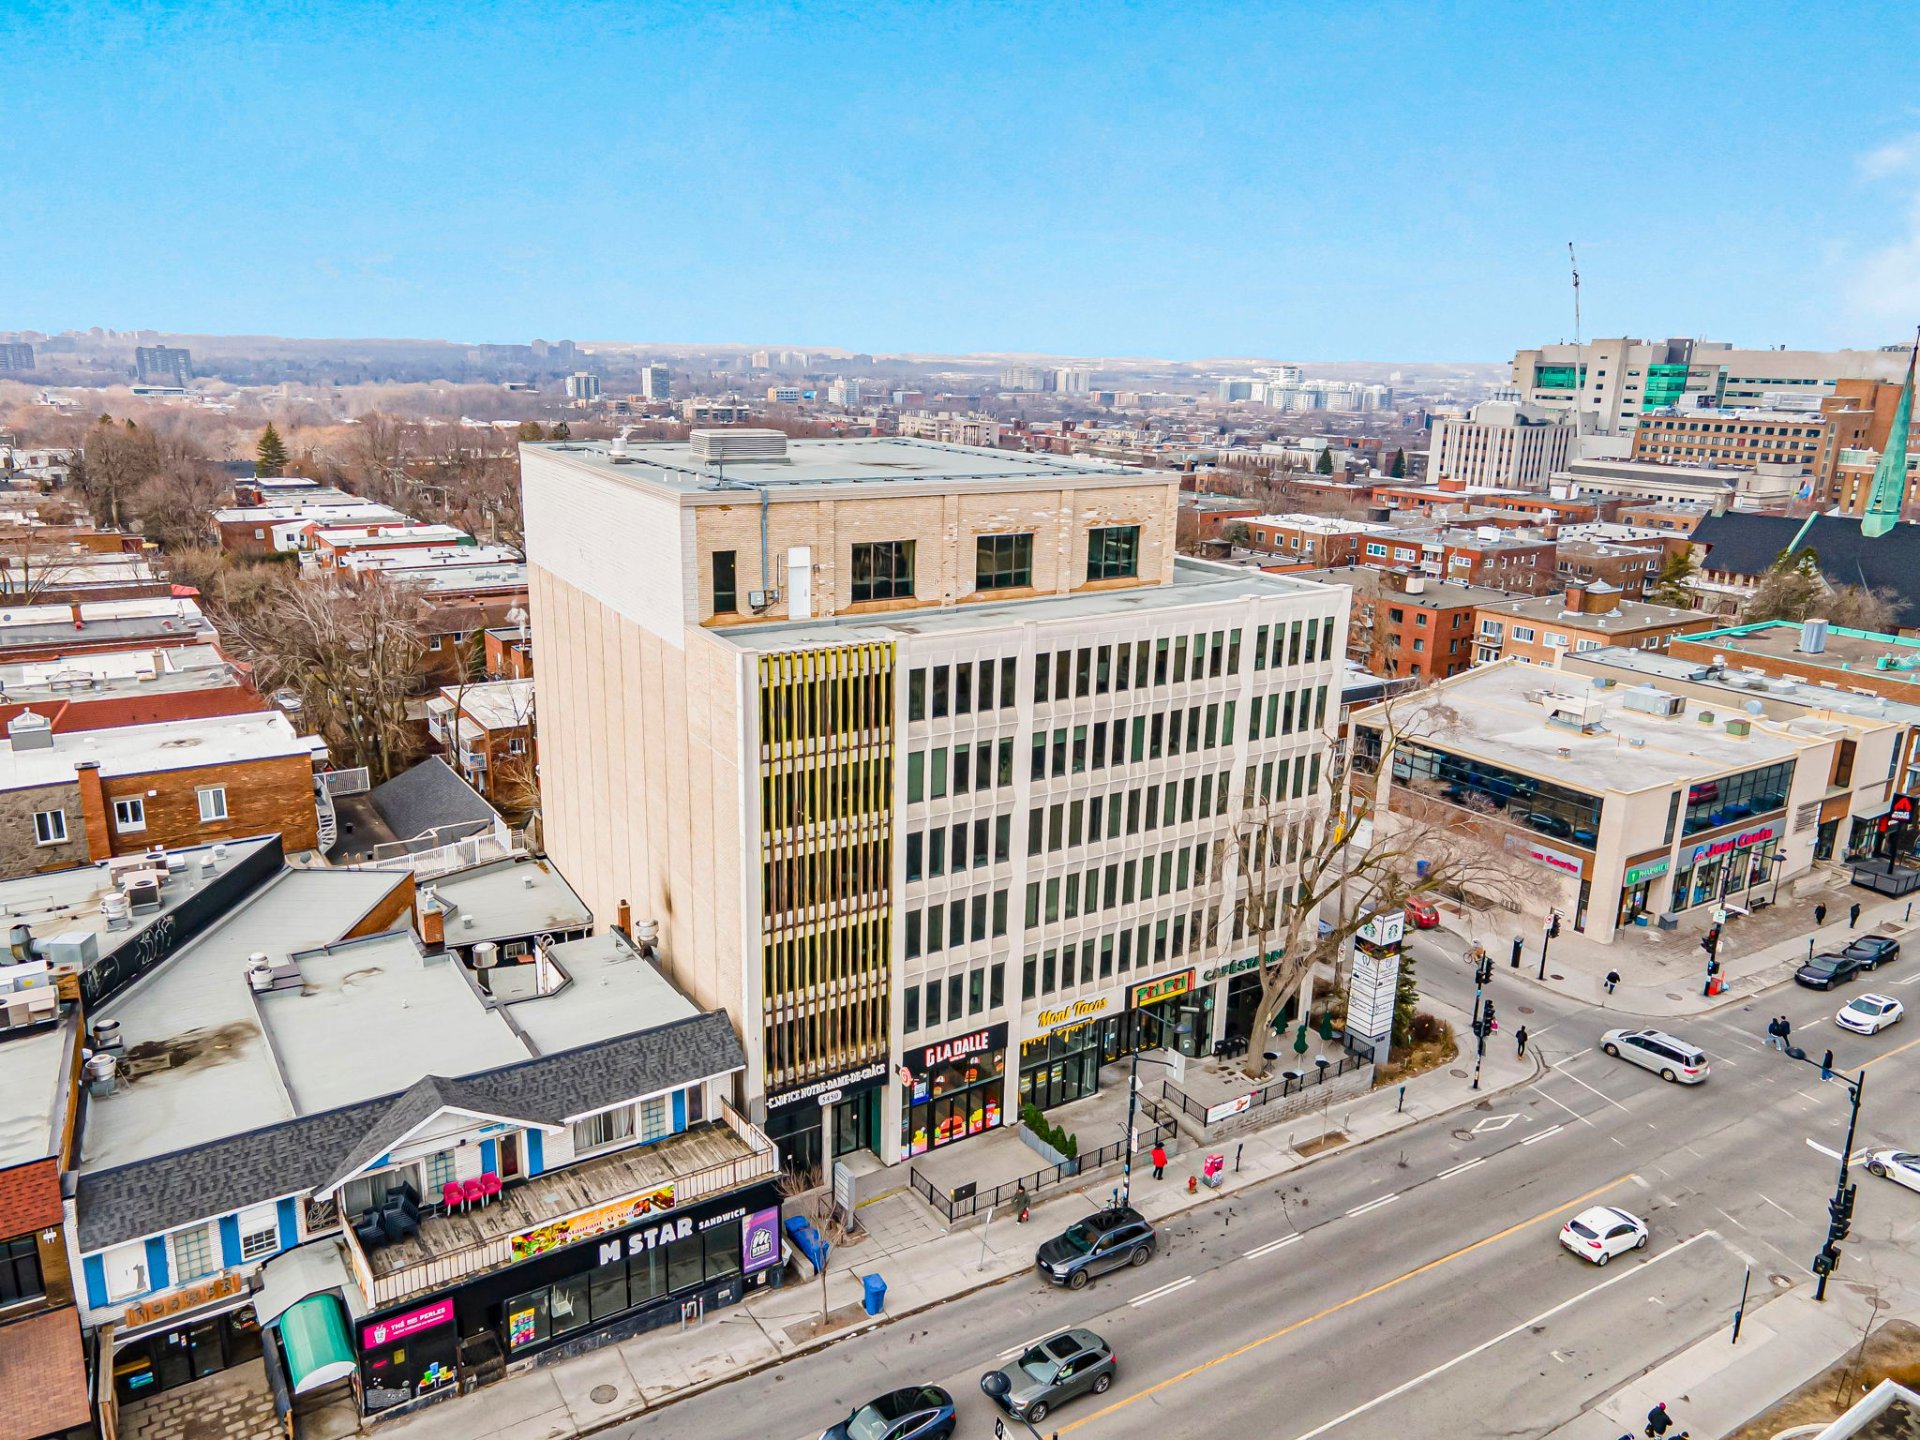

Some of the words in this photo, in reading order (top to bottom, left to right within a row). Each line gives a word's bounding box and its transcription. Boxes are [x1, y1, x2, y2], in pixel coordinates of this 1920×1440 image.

[1705, 838, 1736, 858] Jean
[1737, 827, 1773, 847] Coutu
[1545, 855, 1579, 873] Coutu
[1038, 1005, 1071, 1028] Mont
[1073, 997, 1108, 1017] Tacos
[698, 1207, 746, 1231] SANDWICH
[599, 1239, 622, 1266] M
[628, 1216, 694, 1255] STAR
